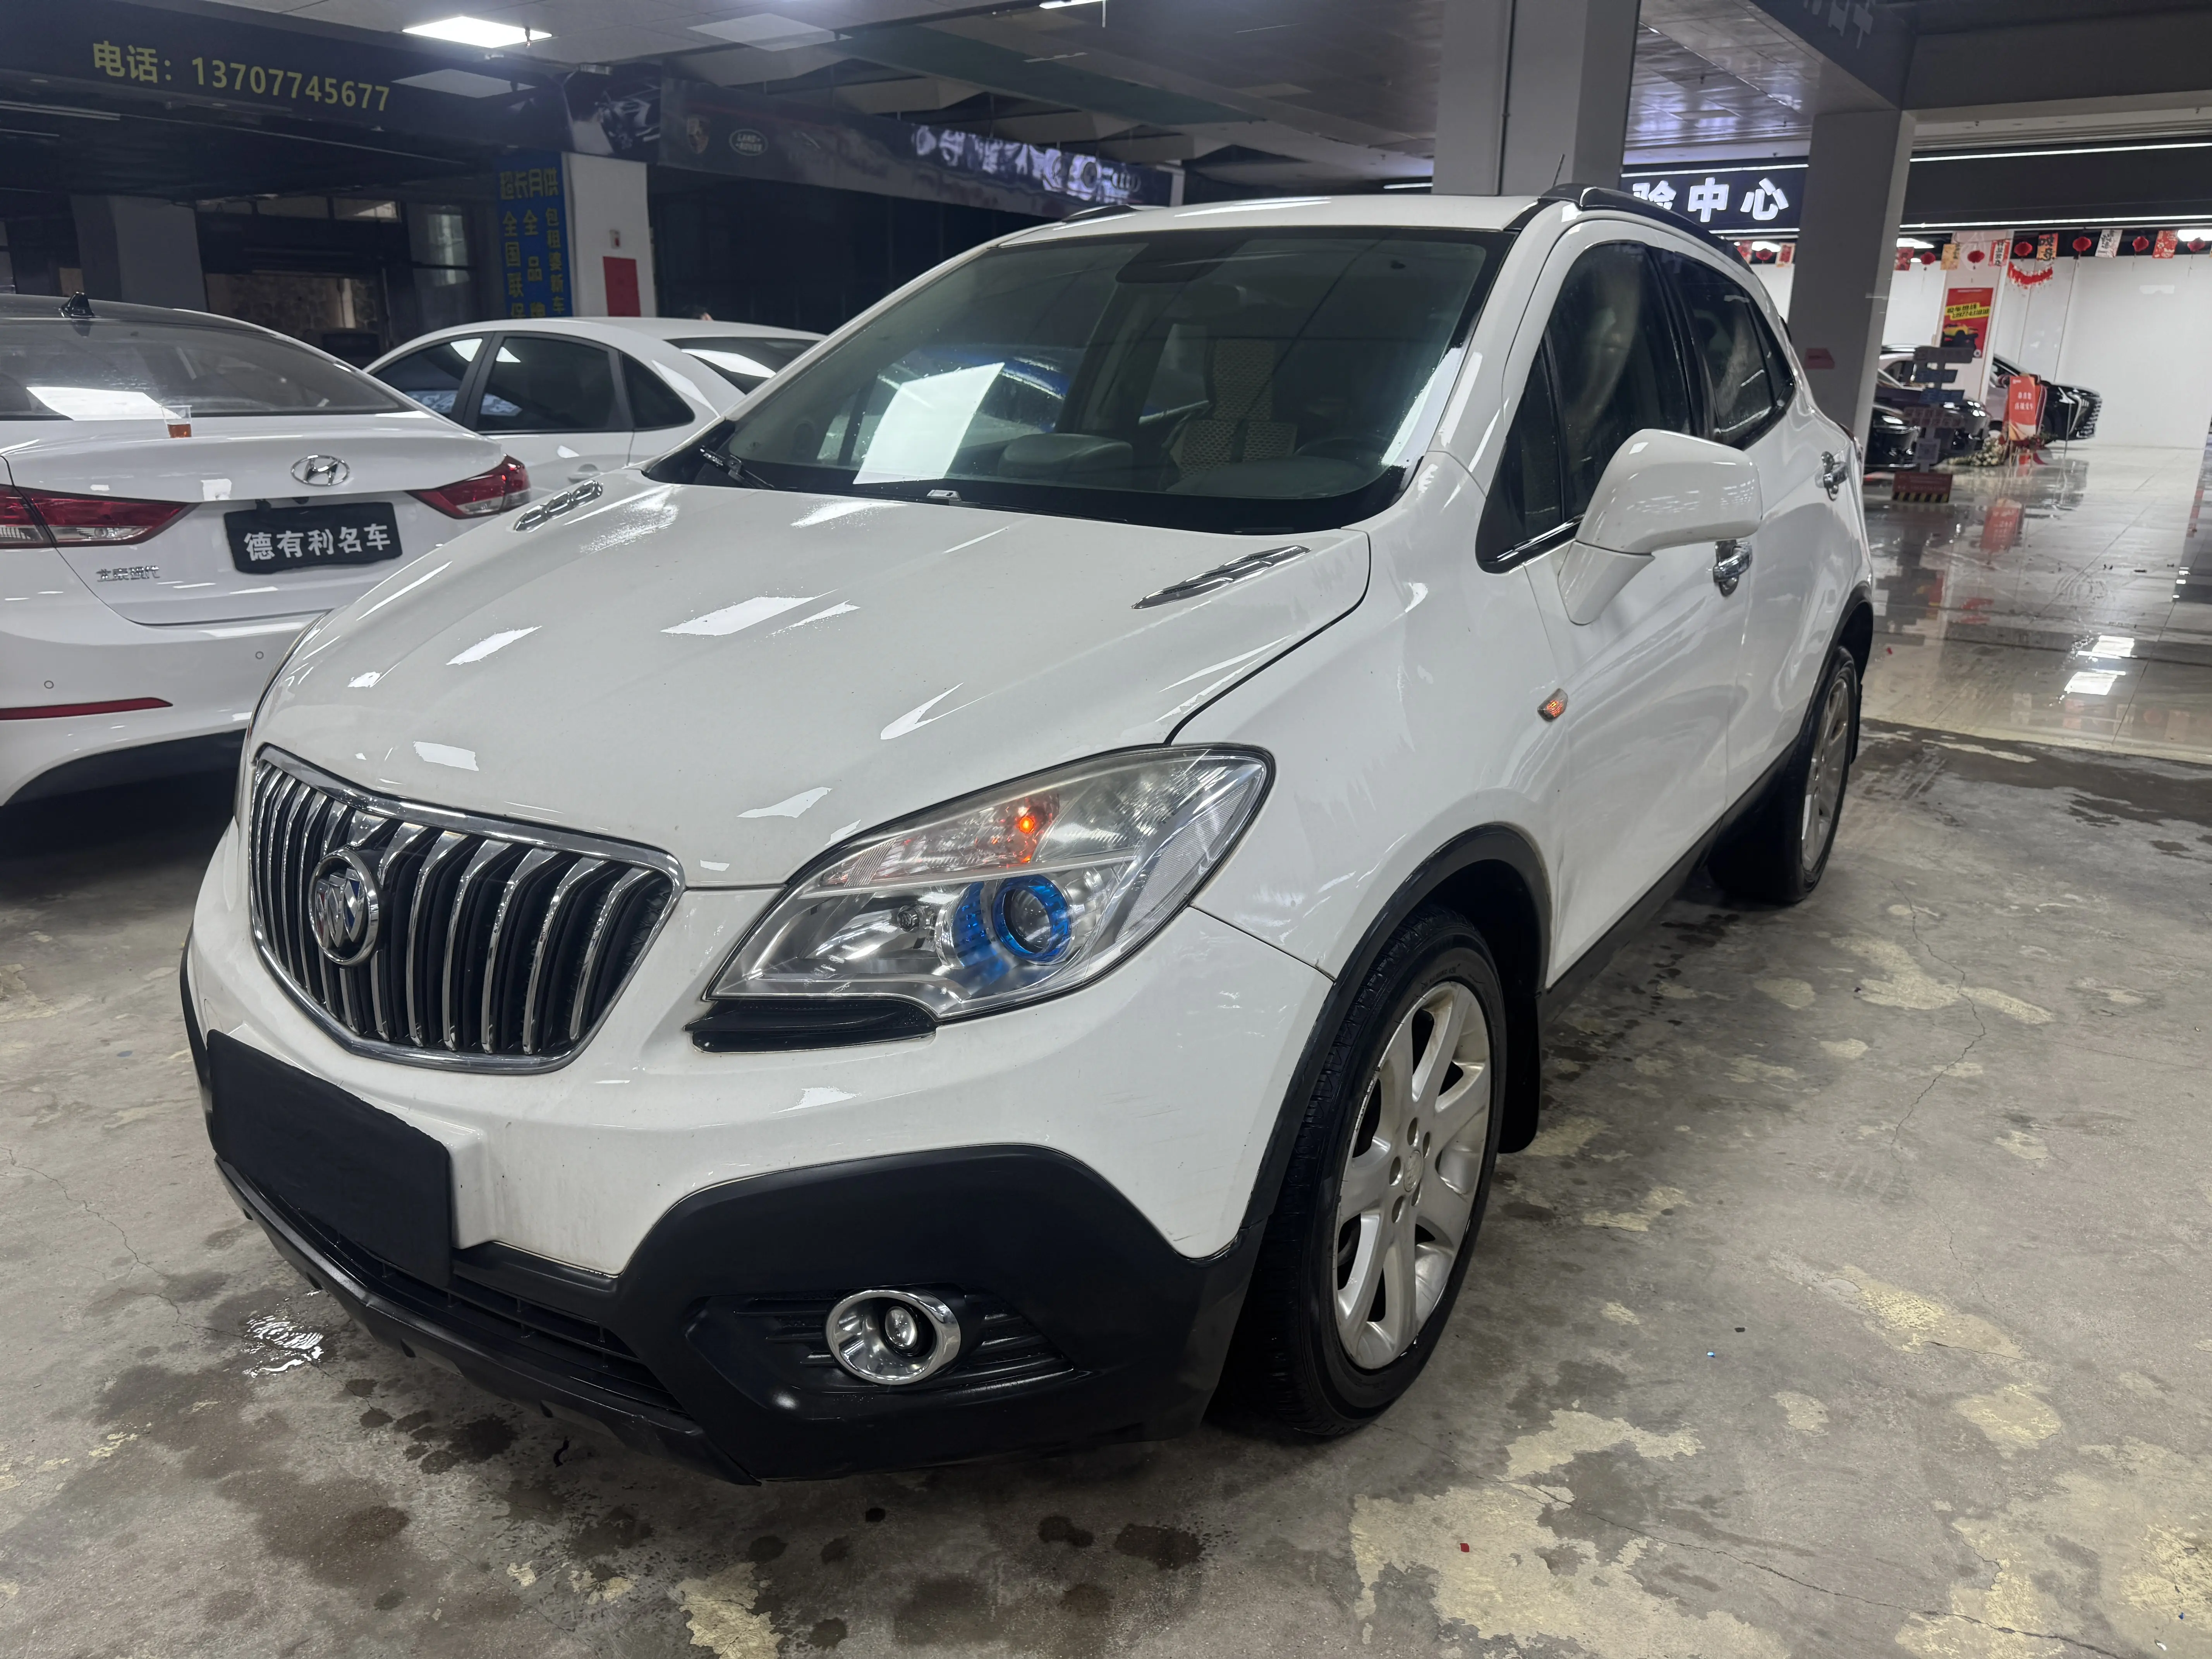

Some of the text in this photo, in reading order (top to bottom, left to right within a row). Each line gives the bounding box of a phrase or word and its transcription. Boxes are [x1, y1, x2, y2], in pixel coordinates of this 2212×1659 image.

[244, 524, 390, 561] 德有利名车
